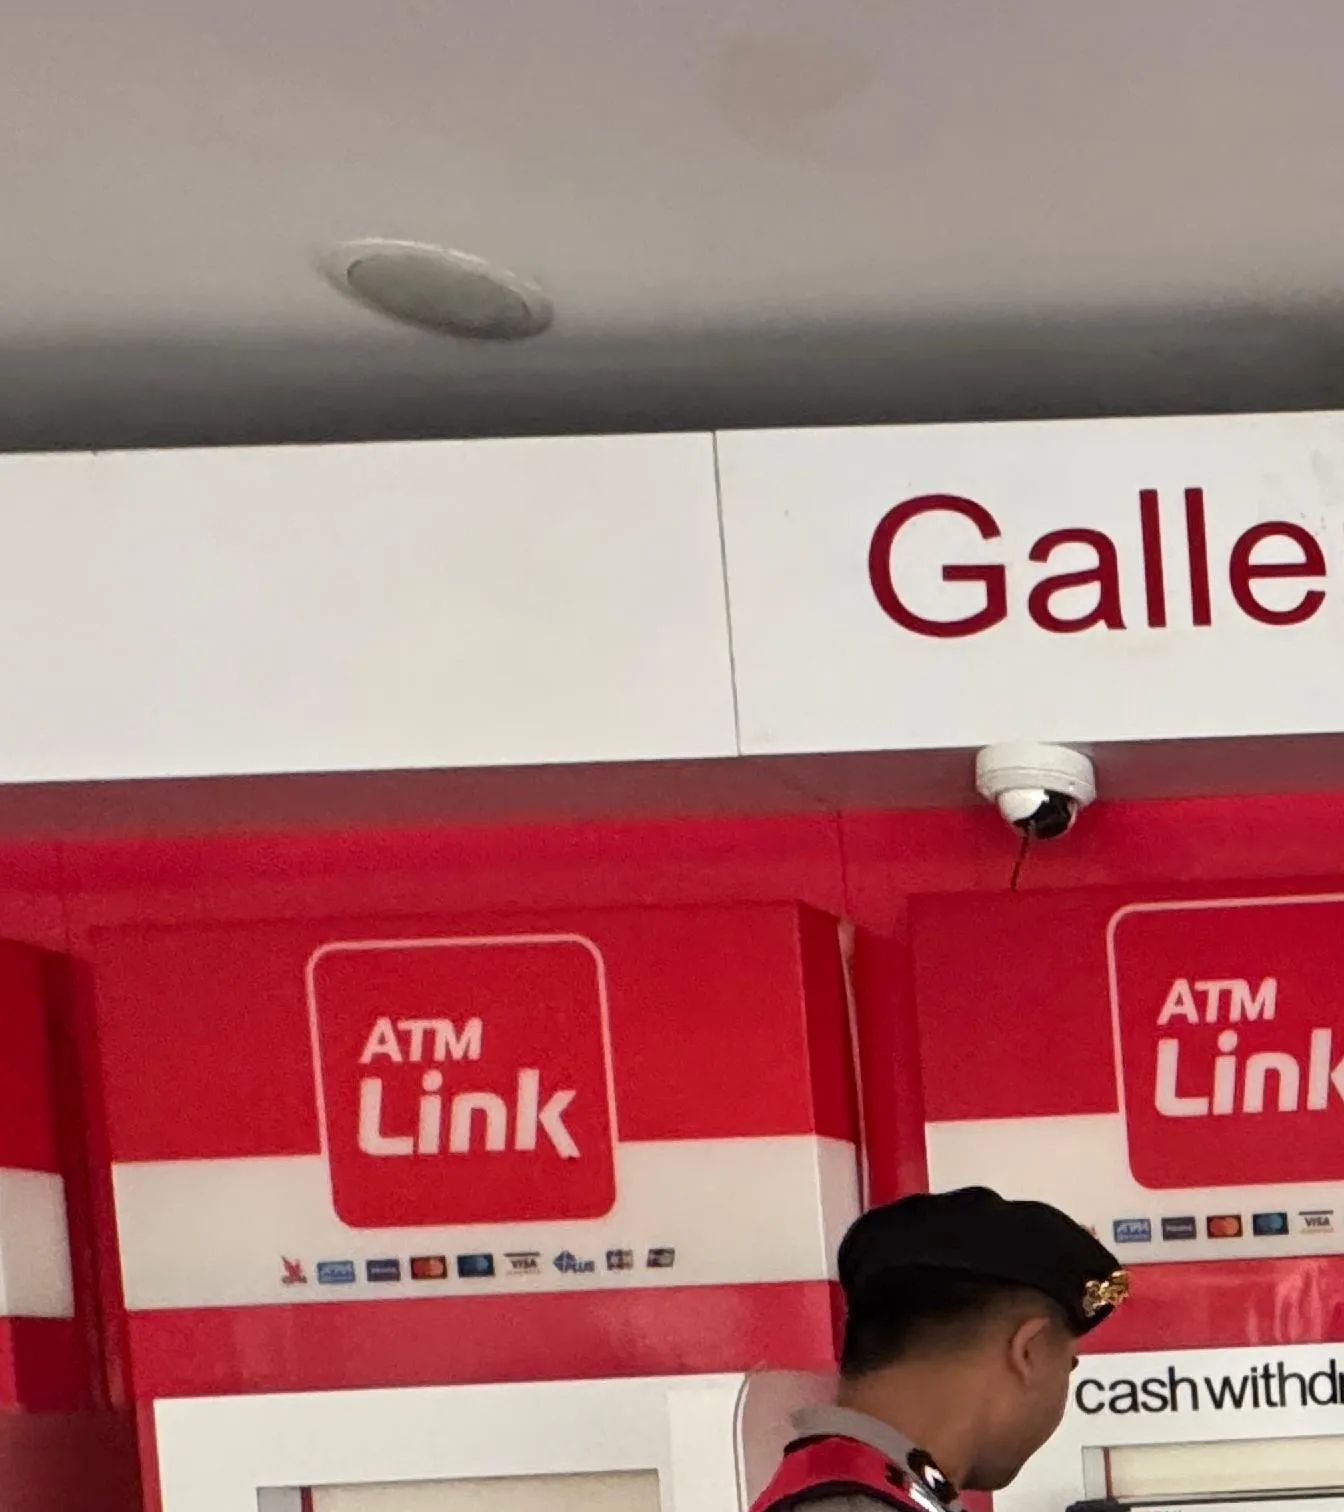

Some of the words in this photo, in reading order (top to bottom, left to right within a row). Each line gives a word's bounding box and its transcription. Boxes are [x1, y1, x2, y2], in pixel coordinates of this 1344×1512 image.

[1157, 977, 1278, 1026] ATM
[359, 1017, 483, 1064] ATM
[358, 1068, 580, 1158] Link
